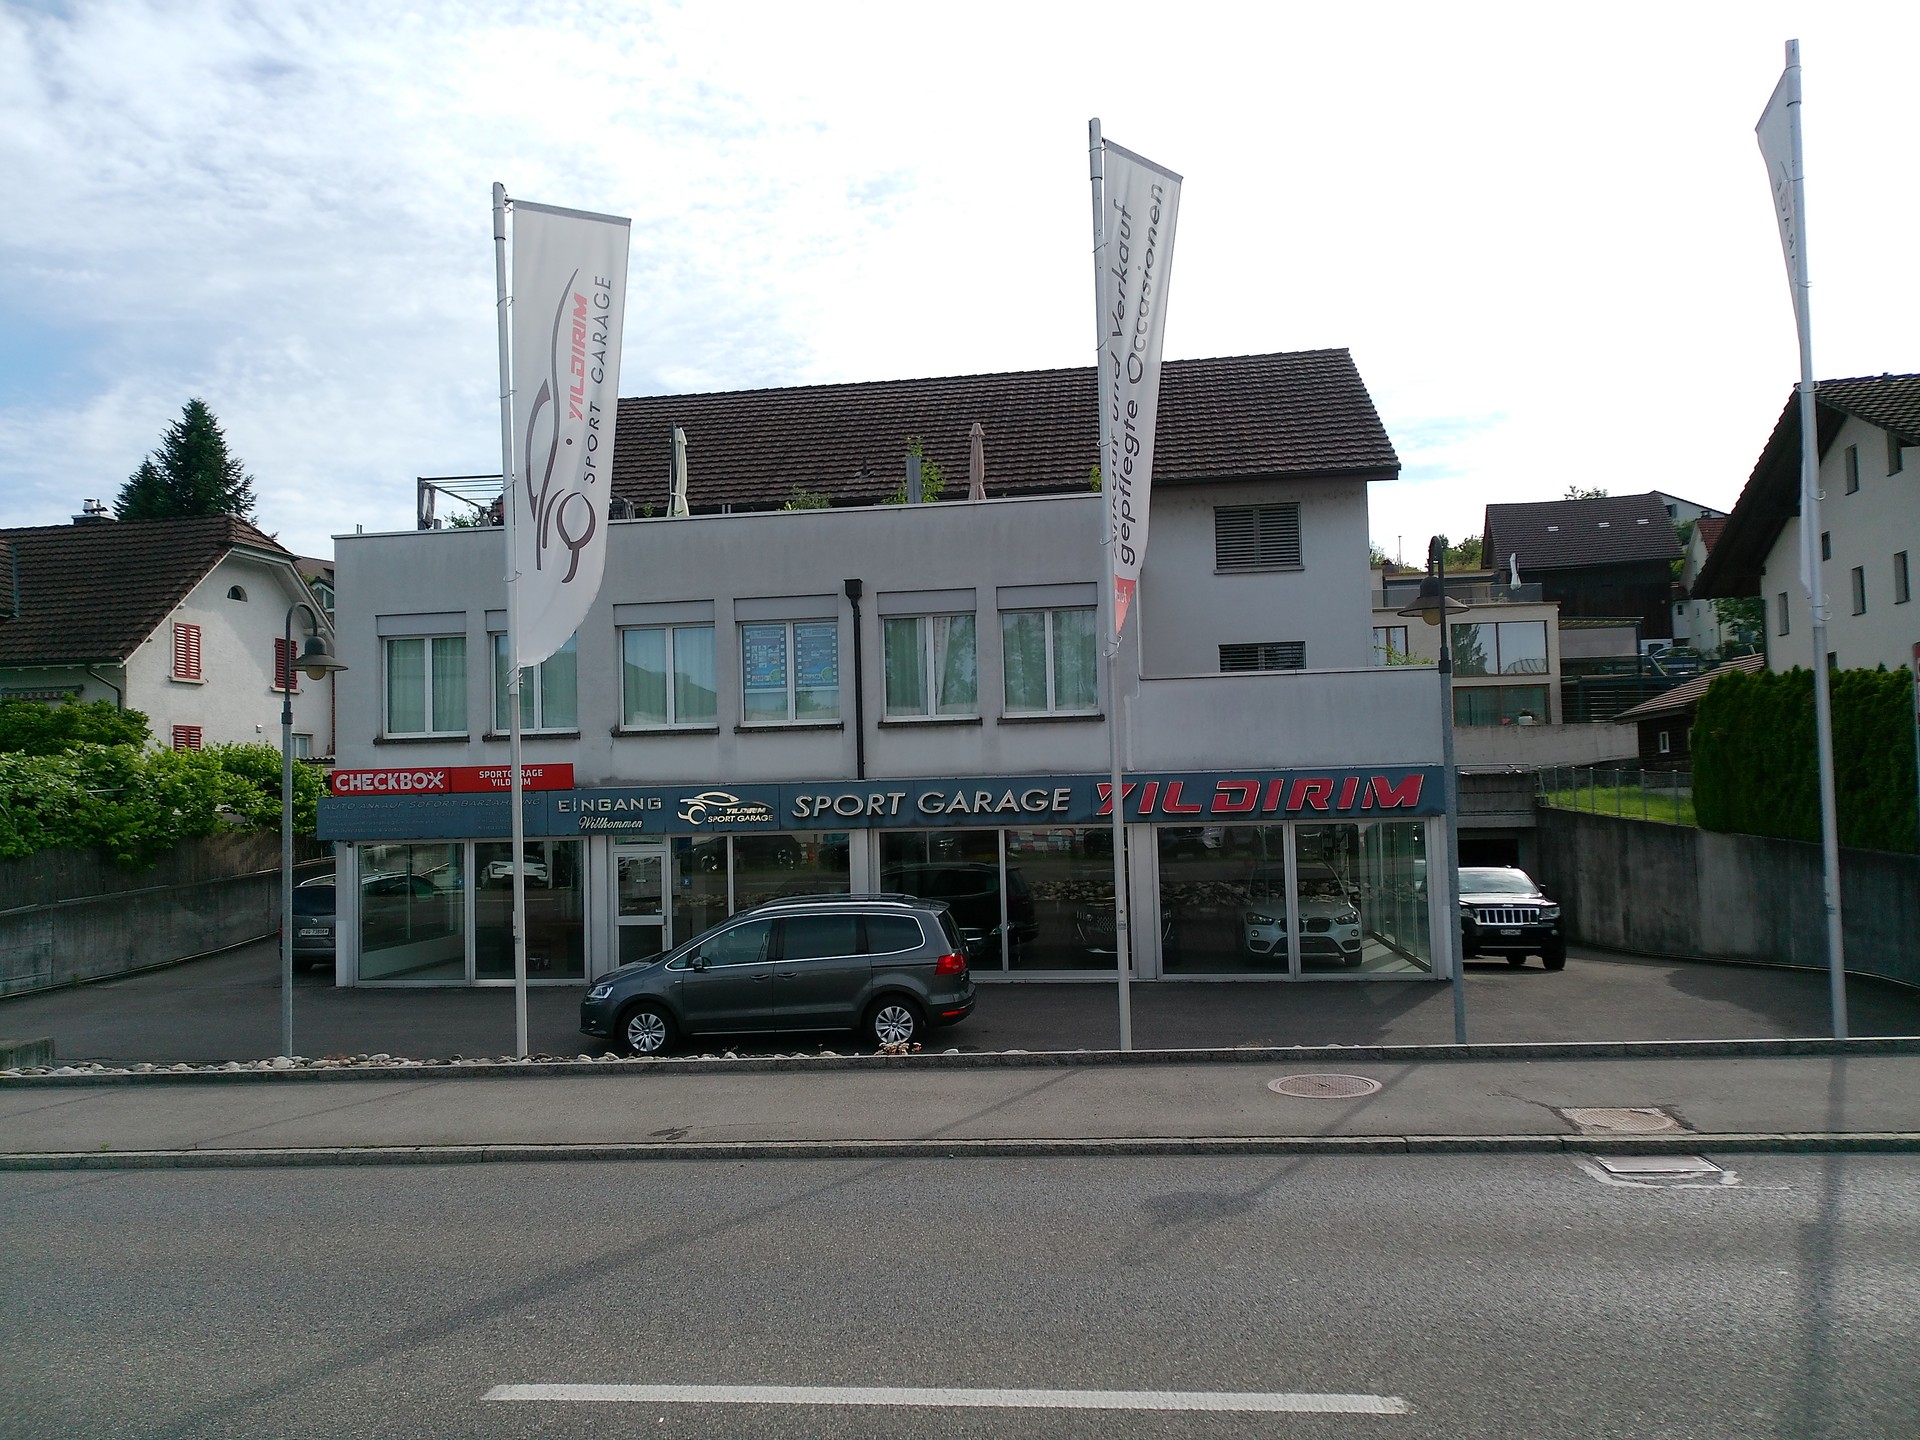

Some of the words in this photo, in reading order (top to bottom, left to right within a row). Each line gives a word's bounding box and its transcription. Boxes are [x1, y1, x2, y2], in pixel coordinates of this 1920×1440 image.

[1111, 198, 1132, 338] Verkauf
[1127, 183, 1164, 384] Occasionen
[569, 292, 588, 421] YILDIRIM
[590, 276, 612, 384] GARAGE
[583, 401, 601, 484] SPORT
[1118, 399, 1140, 566] gepflegte
[358, 802, 405, 810] ANKAUF
[409, 800, 457, 809] SOFORT
[479, 769, 543, 779] SPORTGRAGE
[791, 792, 906, 818] SPORT
[917, 788, 1071, 814] GARAGE
[1095, 774, 1424, 816] YILDIRIM
[579, 816, 643, 829] Willkommen
[708, 815, 736, 823] SPORT
[737, 814, 773, 822] GARAGE
